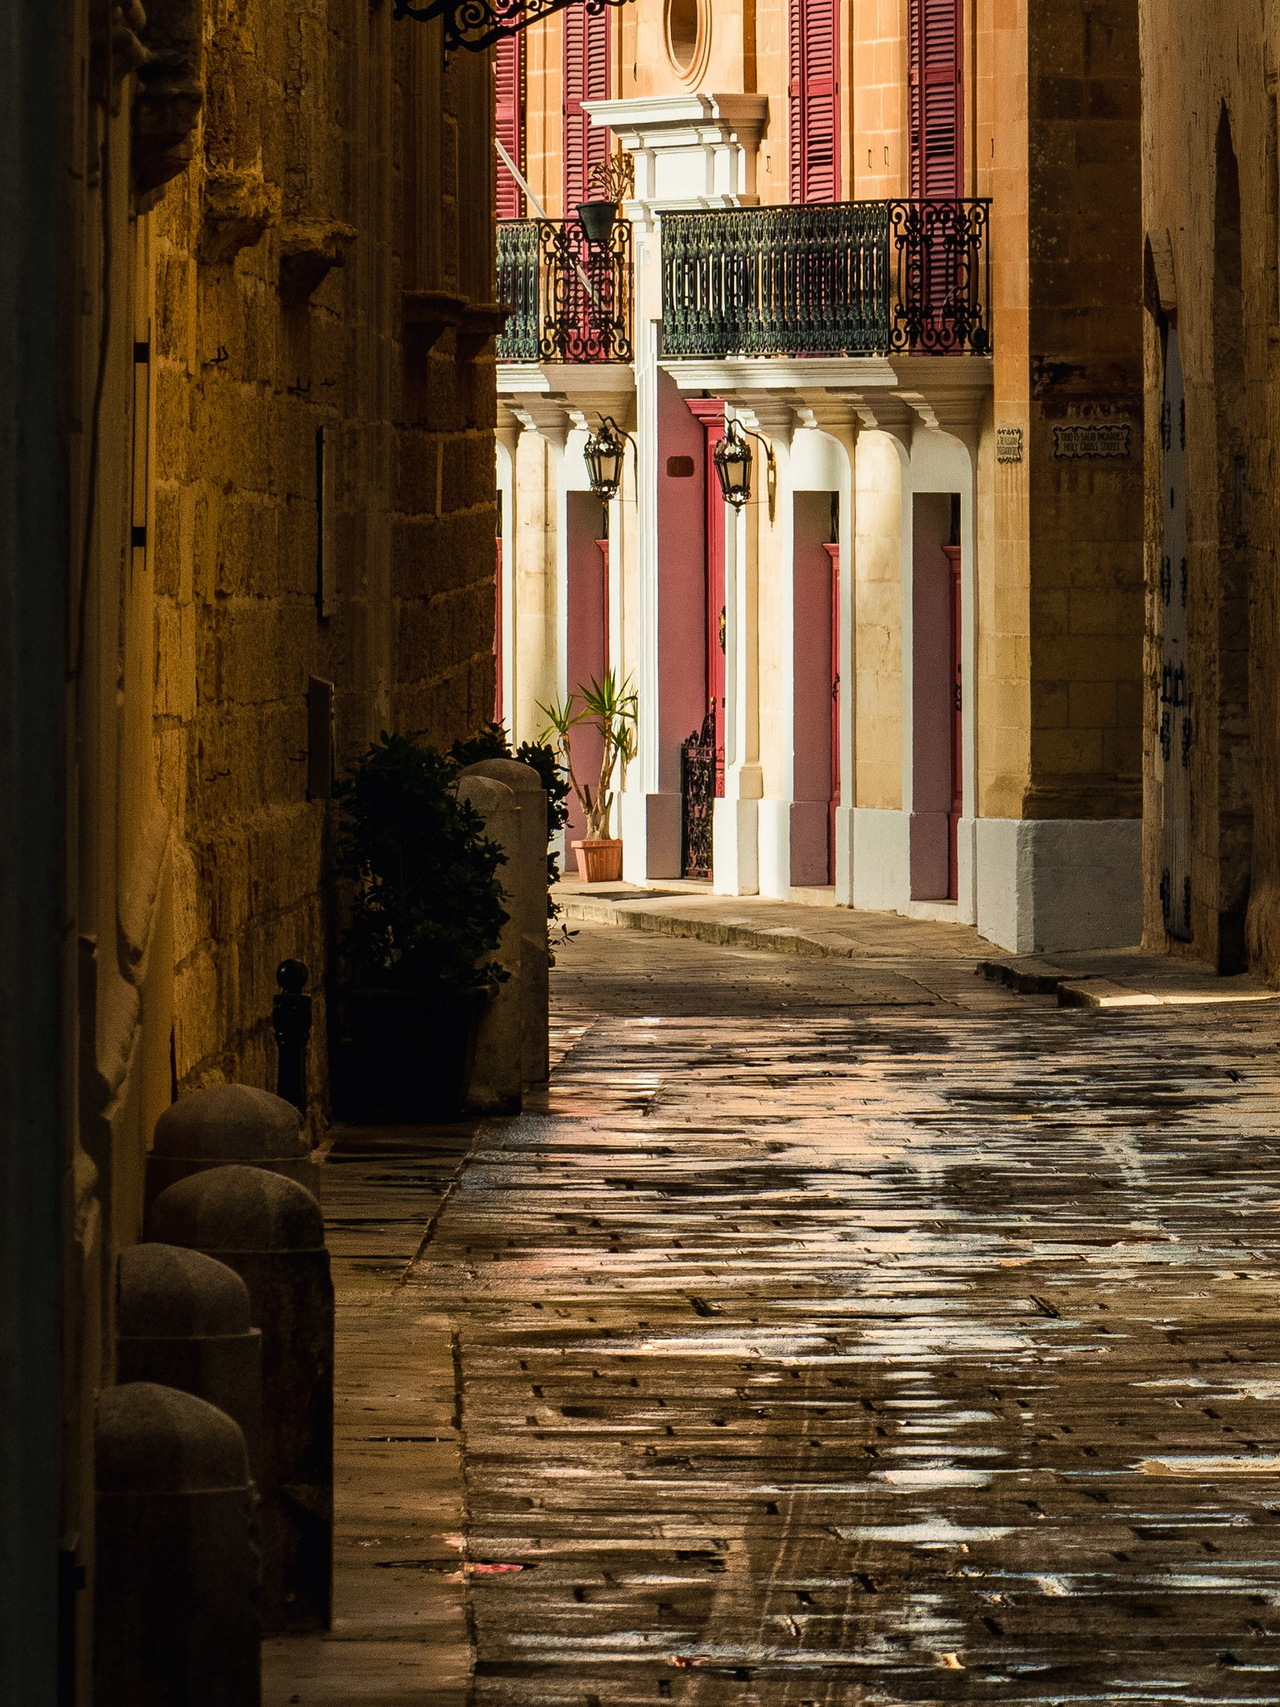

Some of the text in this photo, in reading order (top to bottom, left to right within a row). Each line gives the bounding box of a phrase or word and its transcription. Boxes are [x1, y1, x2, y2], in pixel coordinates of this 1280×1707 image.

[1064, 442, 1120, 451] HOLY CROSS STREET
